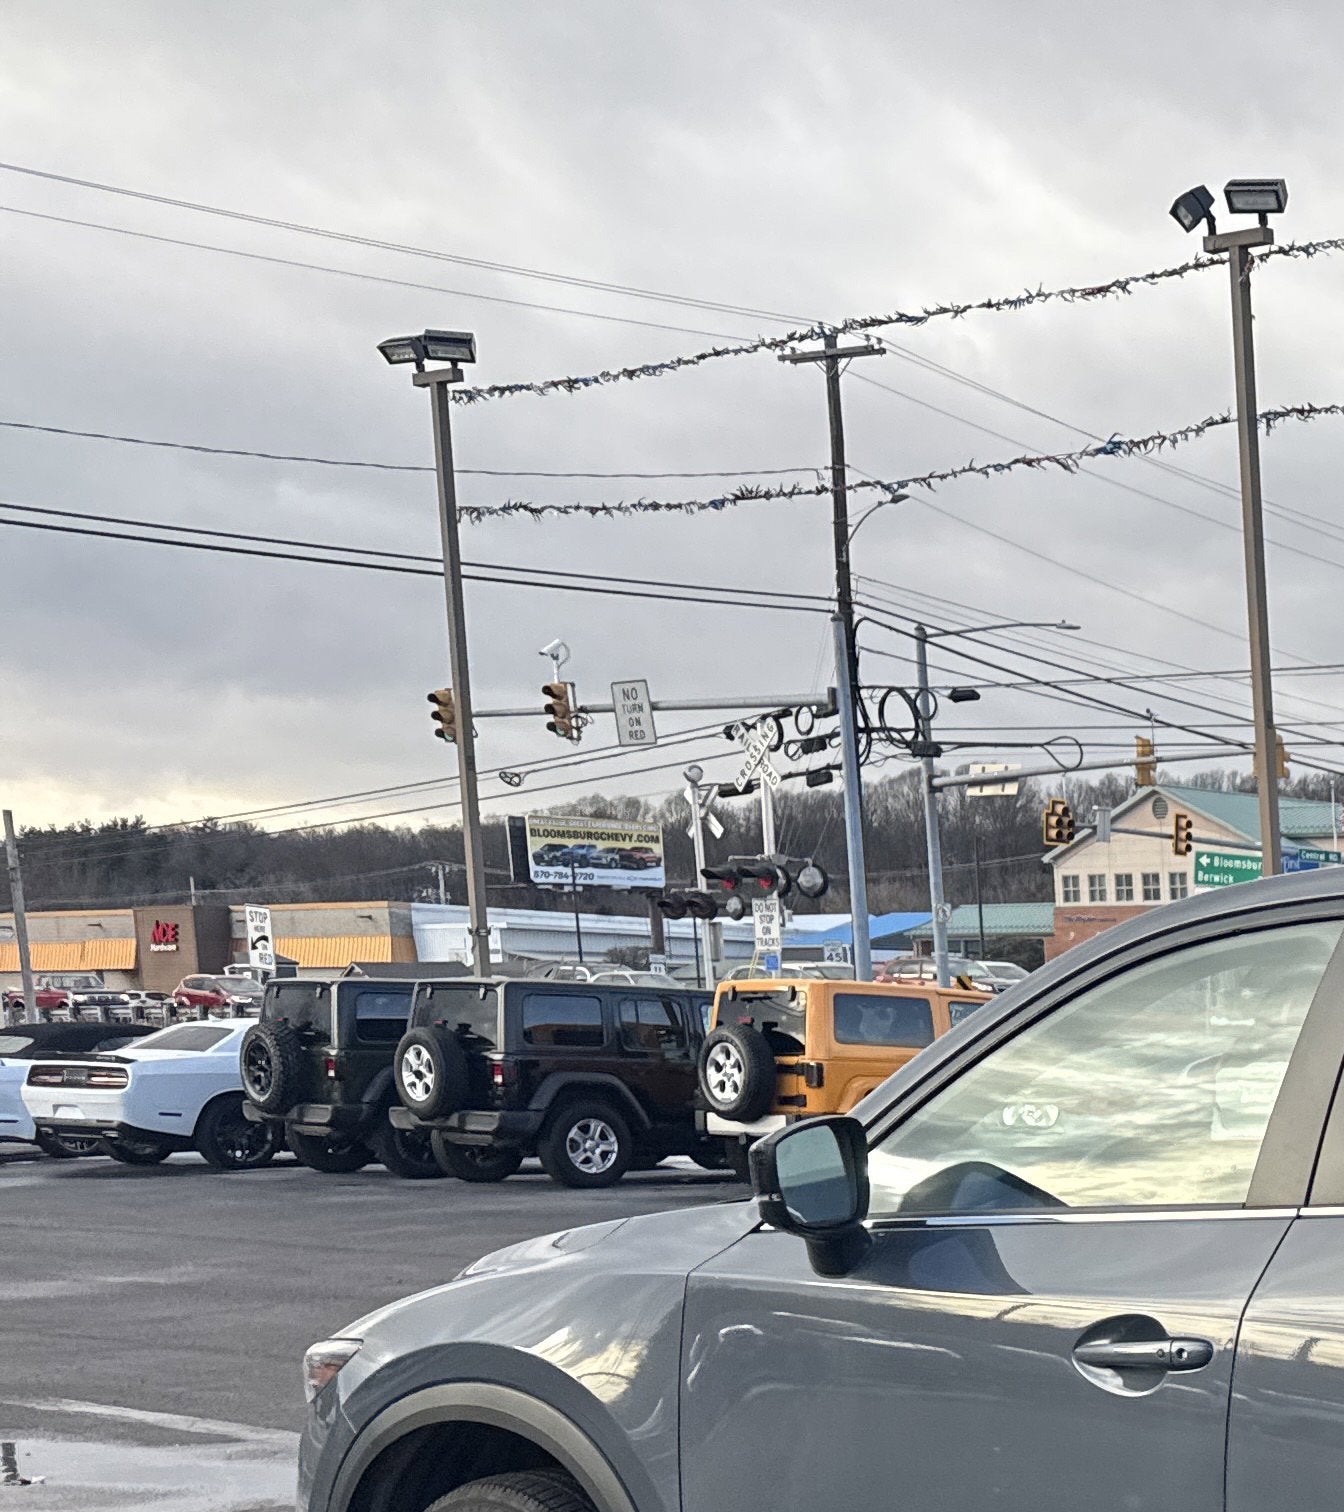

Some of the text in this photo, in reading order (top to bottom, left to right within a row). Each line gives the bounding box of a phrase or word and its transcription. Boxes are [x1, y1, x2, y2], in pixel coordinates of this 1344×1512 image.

[622, 687, 638, 701] NO
[622, 703, 644, 714] TURN
[628, 716, 641, 727] ON
[628, 729, 646, 741] RED
[735, 721, 775, 788] CROSSING
[530, 827, 660, 844] BLOOMSBURGCHEVY.COM
[1213, 855, 1263, 871] Bloomsbur
[1198, 870, 1235, 884] Berwick
[754, 902, 777, 913] DO NOT
[249, 910, 268, 923] STOP
[758, 914, 774, 924] STOP
[151, 920, 179, 943] ACE
[761, 926, 772, 936] ON
[756, 937, 780, 948] TRACKS
[258, 953, 273, 966] RED
[826, 953, 843, 963] 45
